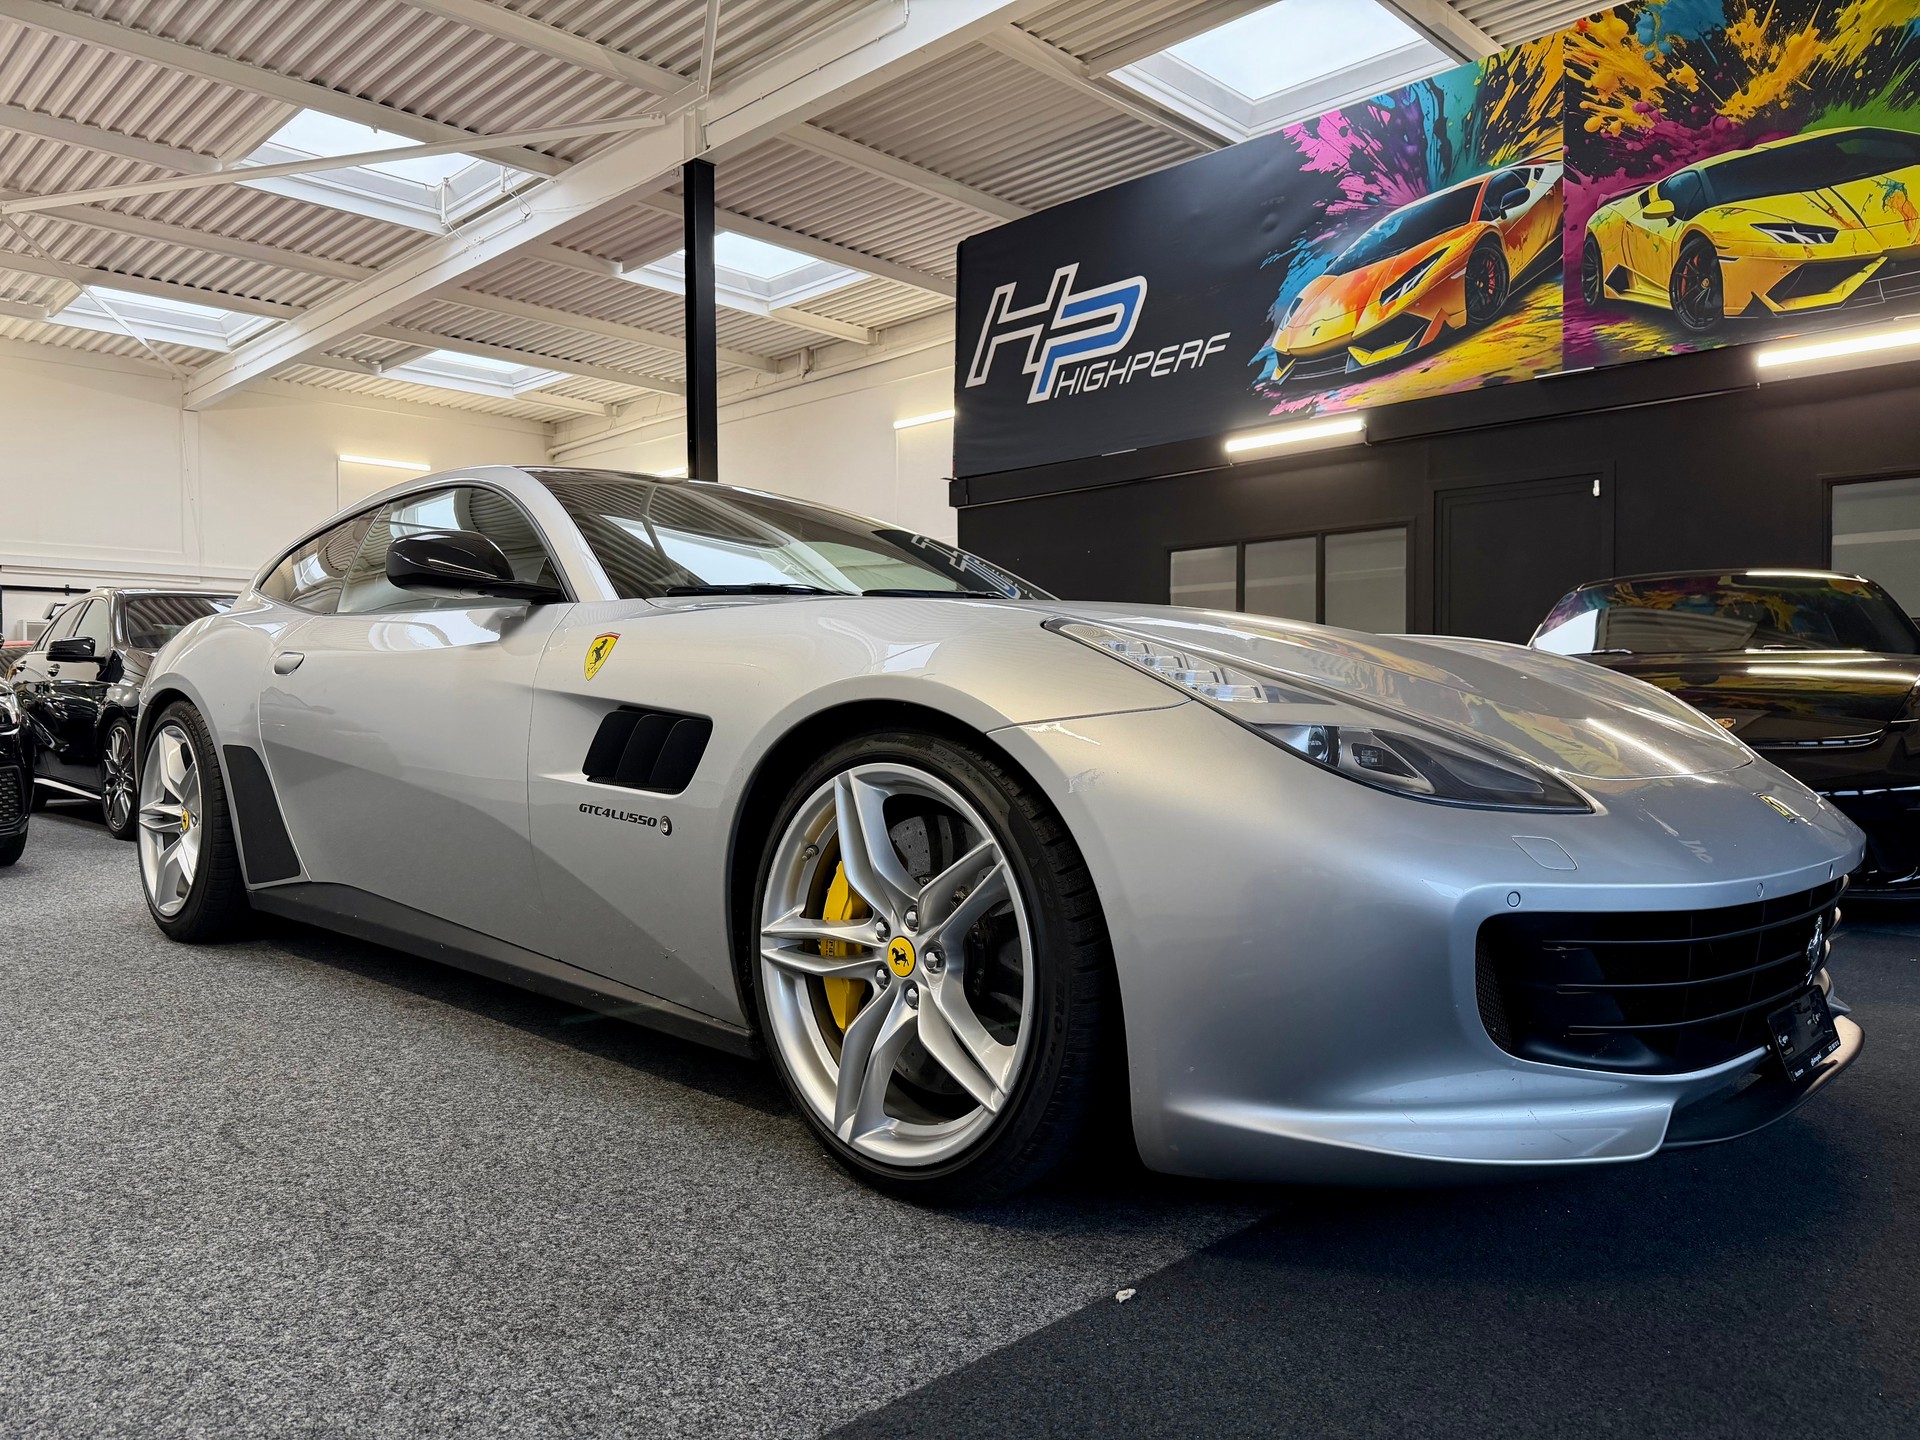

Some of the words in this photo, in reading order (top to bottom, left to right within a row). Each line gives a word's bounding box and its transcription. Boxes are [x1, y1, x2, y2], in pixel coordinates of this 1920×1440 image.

[965, 262, 1147, 404] HP
[1054, 332, 1231, 398] HIGHPERF
[579, 803, 657, 828] GTC4LUSSO
